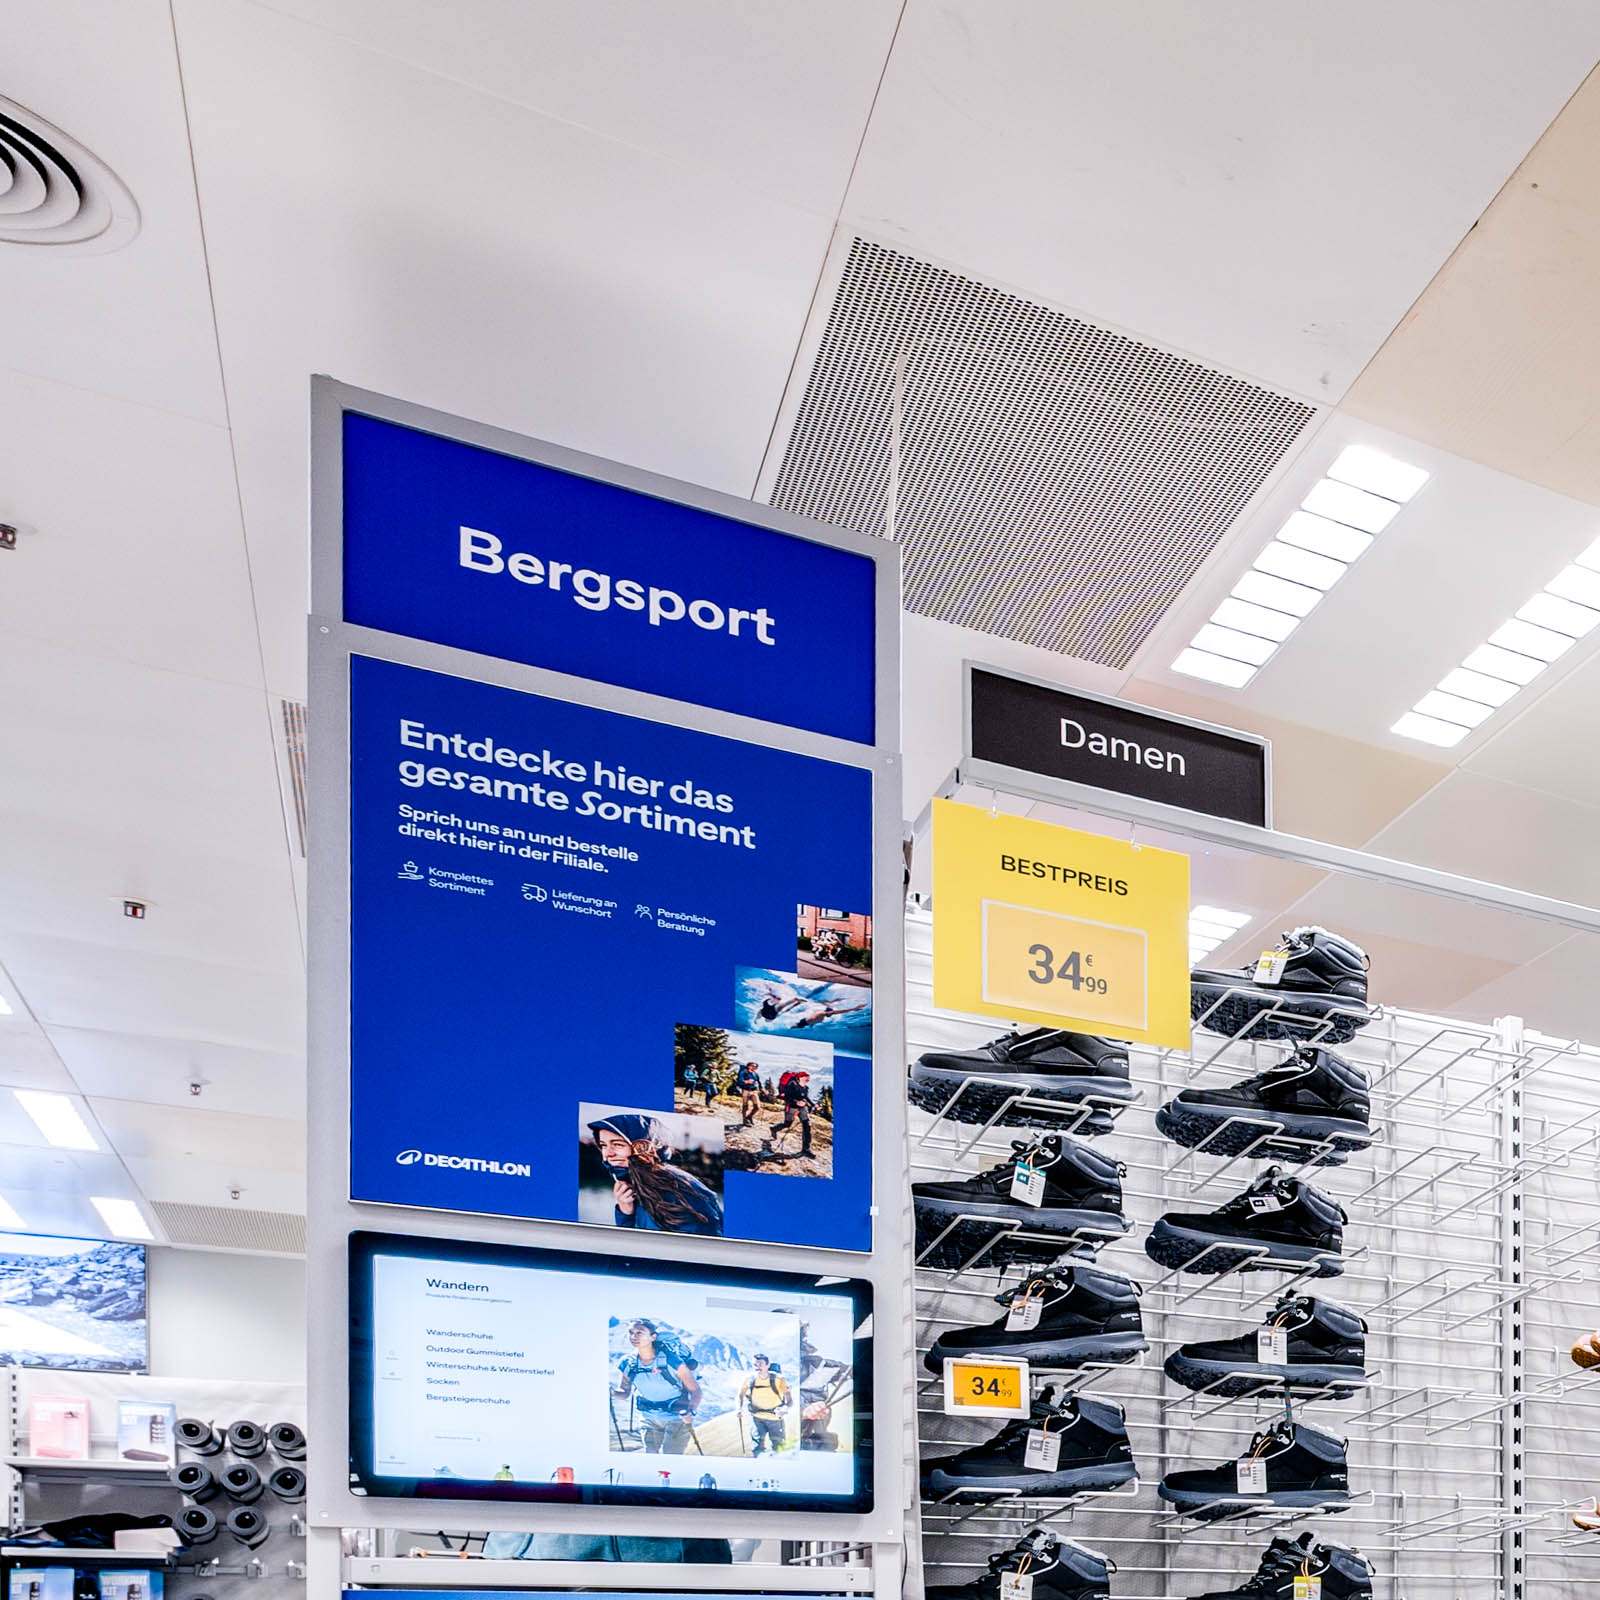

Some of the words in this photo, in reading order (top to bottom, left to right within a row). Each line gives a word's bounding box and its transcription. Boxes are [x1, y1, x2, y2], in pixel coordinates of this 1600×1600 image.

[459, 525, 776, 646] Bergsport
[1060, 717, 1186, 776] Damen
[399, 718, 588, 783] Entdecke
[594, 760, 665, 798] hier
[668, 780, 735, 813] das
[399, 759, 570, 811] gesamte
[575, 790, 757, 850] Sortiment
[399, 803, 463, 829] Sprich
[465, 812, 500, 836] uns
[501, 824, 527, 840] an
[527, 826, 565, 848] und
[566, 835, 639, 862] bestelle
[398, 822, 458, 846] direkt
[459, 832, 498, 852] hier
[498, 840, 517, 856] in
[517, 843, 550, 864] der
[552, 849, 610, 873] Filiale.
[428, 865, 495, 887] Komplettes
[1000, 854, 1129, 896] BESTPREIS
[428, 877, 486, 897] Sortiment
[552, 888, 604, 908] Lieferung
[603, 899, 618, 909] an
[552, 899, 613, 919] Wunschort
[657, 907, 717, 927] Persönliche
[657, 918, 706, 937] Beratung
[423, 1153, 532, 1177] DECATHLON
[425, 1277, 490, 1293] Wandern
[425, 1328, 494, 1341] Wanderschuhe
[425, 1344, 465, 1355] Outdoor
[465, 1347, 525, 1359] Gummistiefel
[425, 1360, 490, 1372] Winterschuhe
[498, 1365, 555, 1376] Winterstiefel
[425, 1377, 460, 1386] Socken
[971, 1376, 1001, 1397] 34
[425, 1393, 511, 1406] Bergsteigerschuhe
